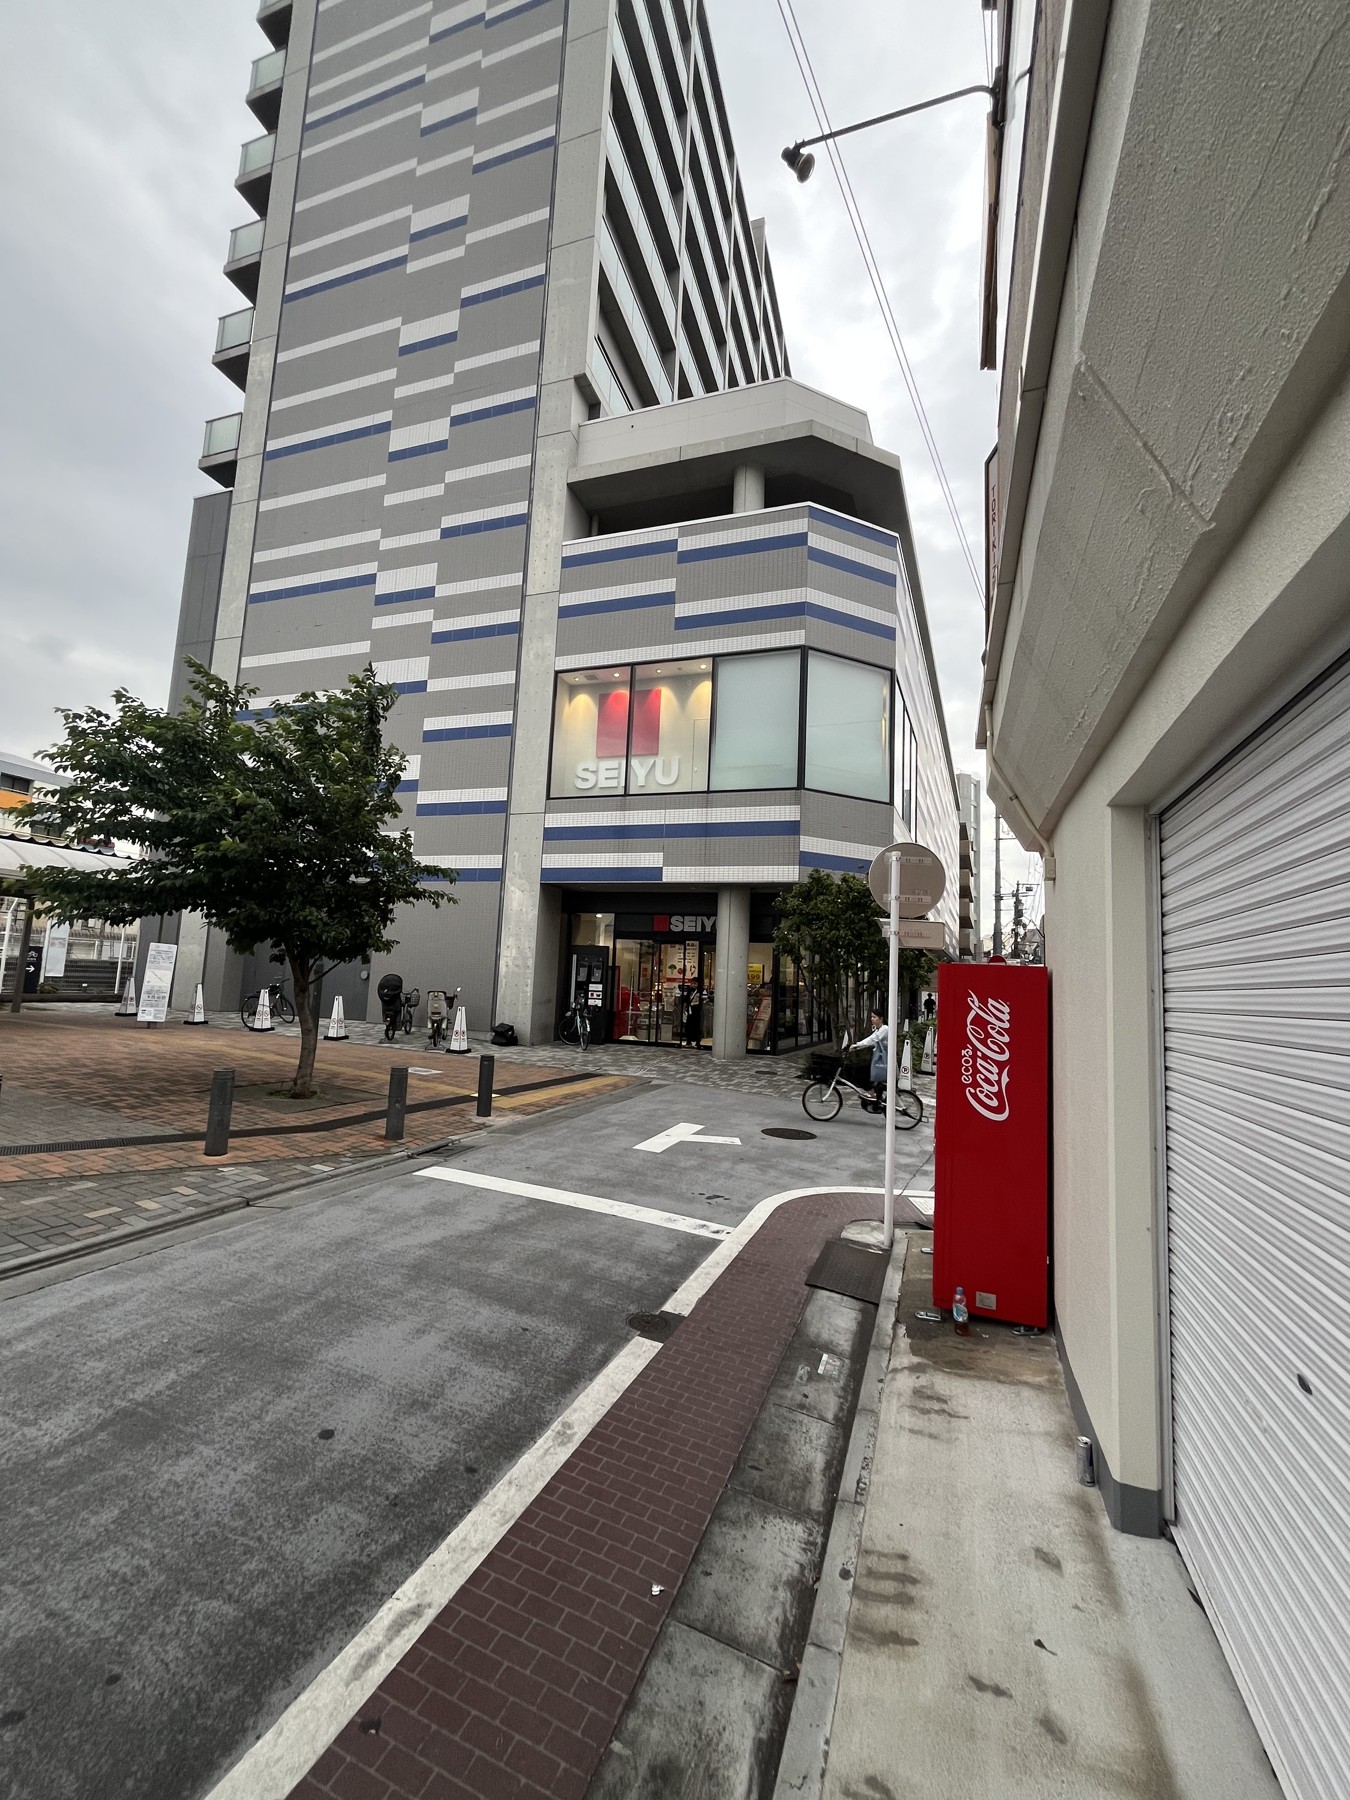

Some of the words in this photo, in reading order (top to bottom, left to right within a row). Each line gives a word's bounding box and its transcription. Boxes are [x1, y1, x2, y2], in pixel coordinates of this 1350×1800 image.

[574, 757, 680, 789] SEIYU
[670, 915, 717, 932] SEIY
[965, 989, 1010, 1121] Coca-Cola
